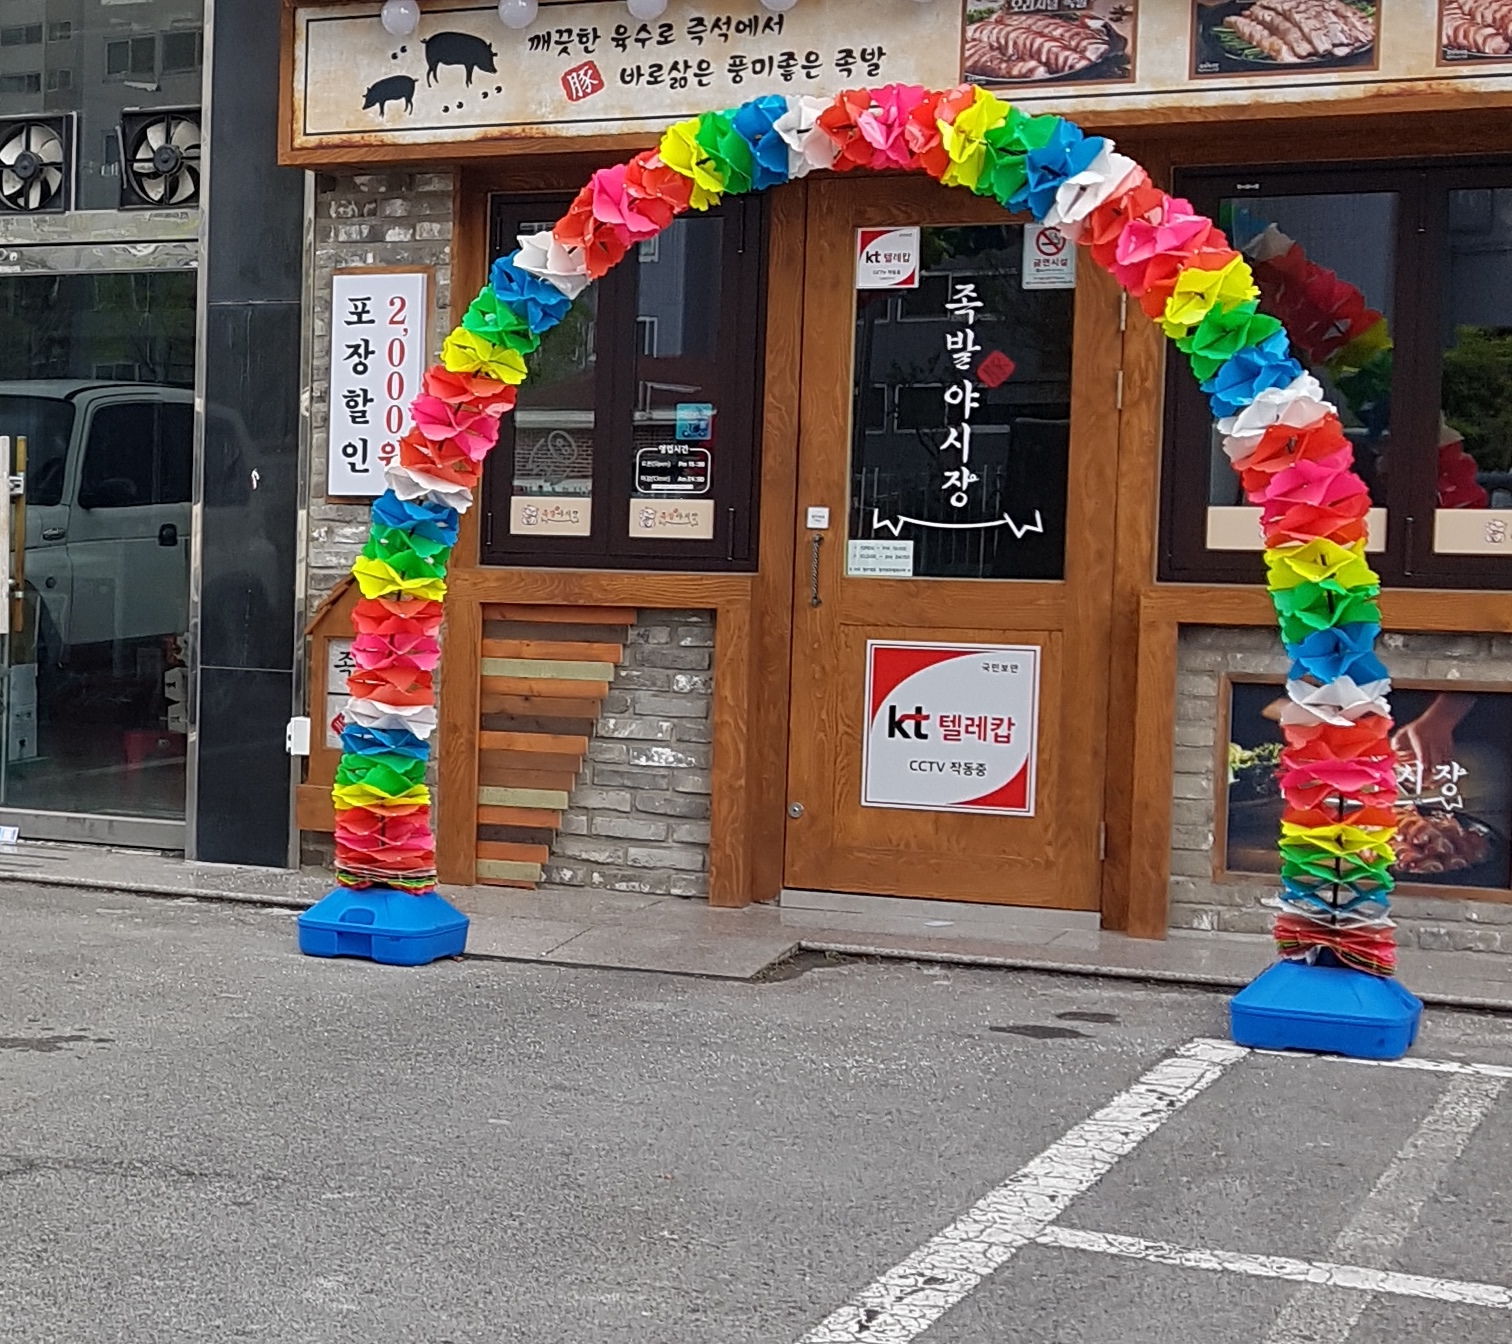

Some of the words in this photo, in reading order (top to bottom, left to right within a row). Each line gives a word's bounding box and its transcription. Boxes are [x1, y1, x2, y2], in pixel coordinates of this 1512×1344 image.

[528, 27, 601, 56] 깨끗한
[611, 23, 676, 53] 육수로
[687, 13, 785, 46] 즉석에서
[620, 59, 715, 90] 바로삶은
[727, 50, 824, 85] 풍미좋은
[835, 46, 888, 79] 족발
[865, 251, 881, 264] kt
[342, 296, 376, 474] 포장할인
[940, 283, 985, 508] 족발야시장
[888, 705, 930, 740] kt
[939, 714, 1016, 744] 텔레캅
[909, 760, 945, 773] CCTV
[949, 762, 987, 777] 작동중
